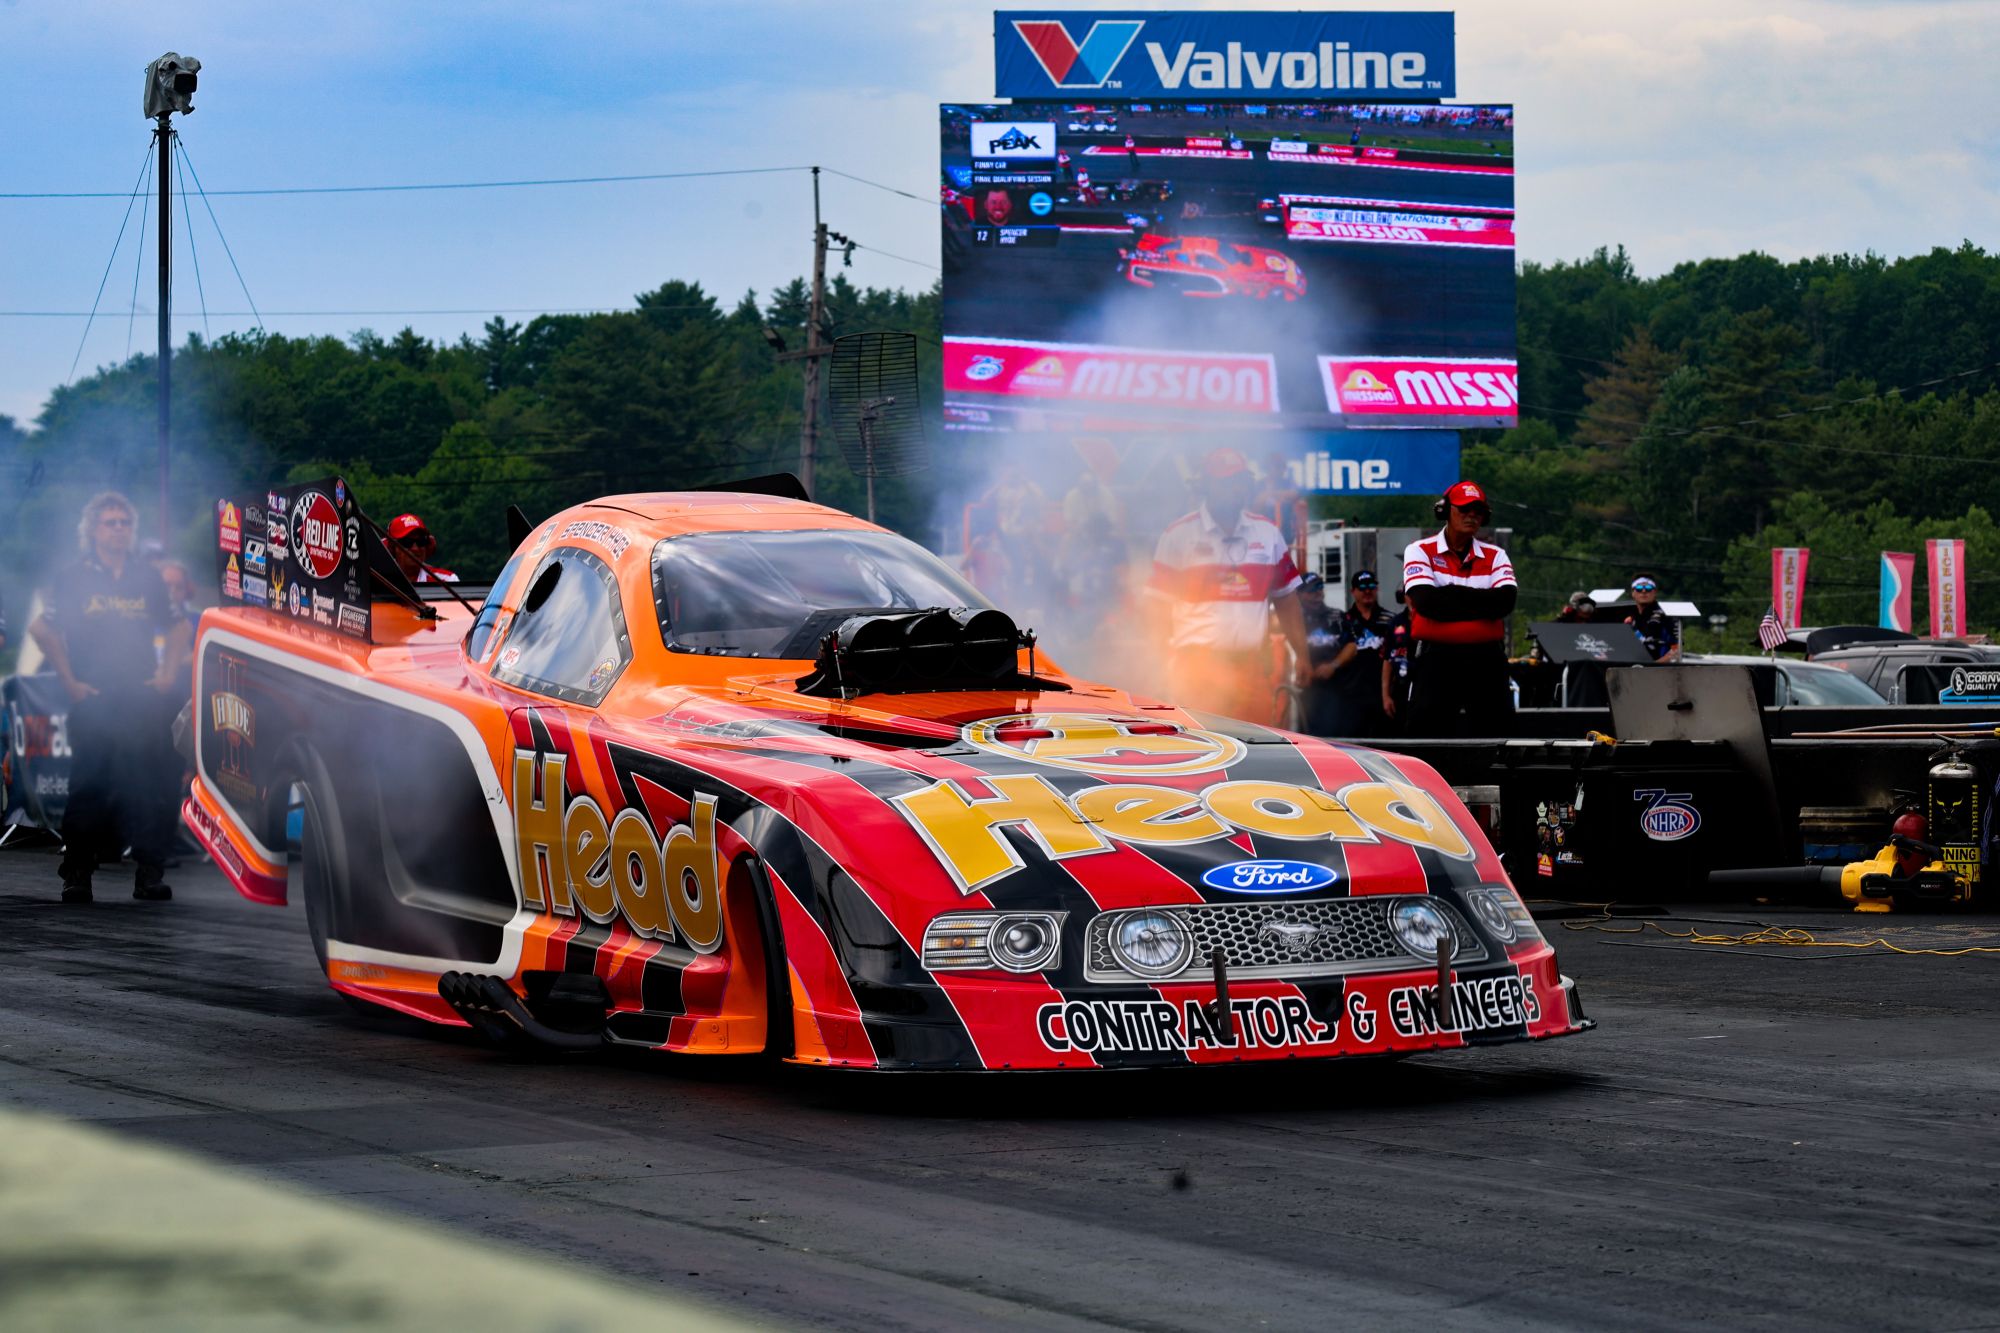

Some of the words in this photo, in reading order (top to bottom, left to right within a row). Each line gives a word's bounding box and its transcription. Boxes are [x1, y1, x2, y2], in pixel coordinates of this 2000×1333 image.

[1145, 42, 1427, 89] Valvoline
[1427, 80, 1442, 88] TM
[1107, 80, 1122, 88] TM
[989, 136, 1041, 154] PEAK
[974, 161, 994, 169] FUNNY
[995, 161, 1007, 169] CAR
[993, 175, 1026, 183] QUALIFYING
[1027, 175, 1052, 183] SESSION
[1000, 228, 1028, 236] SPENCER
[1334, 210, 1353, 222] NEW
[1355, 211, 1393, 225] ENGLAND
[1394, 214, 1448, 226] NATIONALS
[976, 231, 988, 241] 12
[1394, 370, 1518, 408] MISSI
[305, 517, 321, 547] RED
[321, 521, 339, 552] LINE
[559, 520, 613, 544] SPENCER
[603, 526, 631, 561] HYDE
[1785, 556, 1796, 586] ICE
[1942, 548, 1952, 577] ICE
[1785, 591, 1796, 629] CREA
[1942, 583, 1955, 633] CREAM
[1967, 683, 1997, 691] QUALITY
[217, 697, 250, 736] HYDE
[887, 773, 1476, 895] Head
[1650, 812, 1685, 831] NHRA
[513, 748, 724, 954] Head
[1233, 863, 1313, 887] Ford
[1347, 991, 1376, 1043] &
